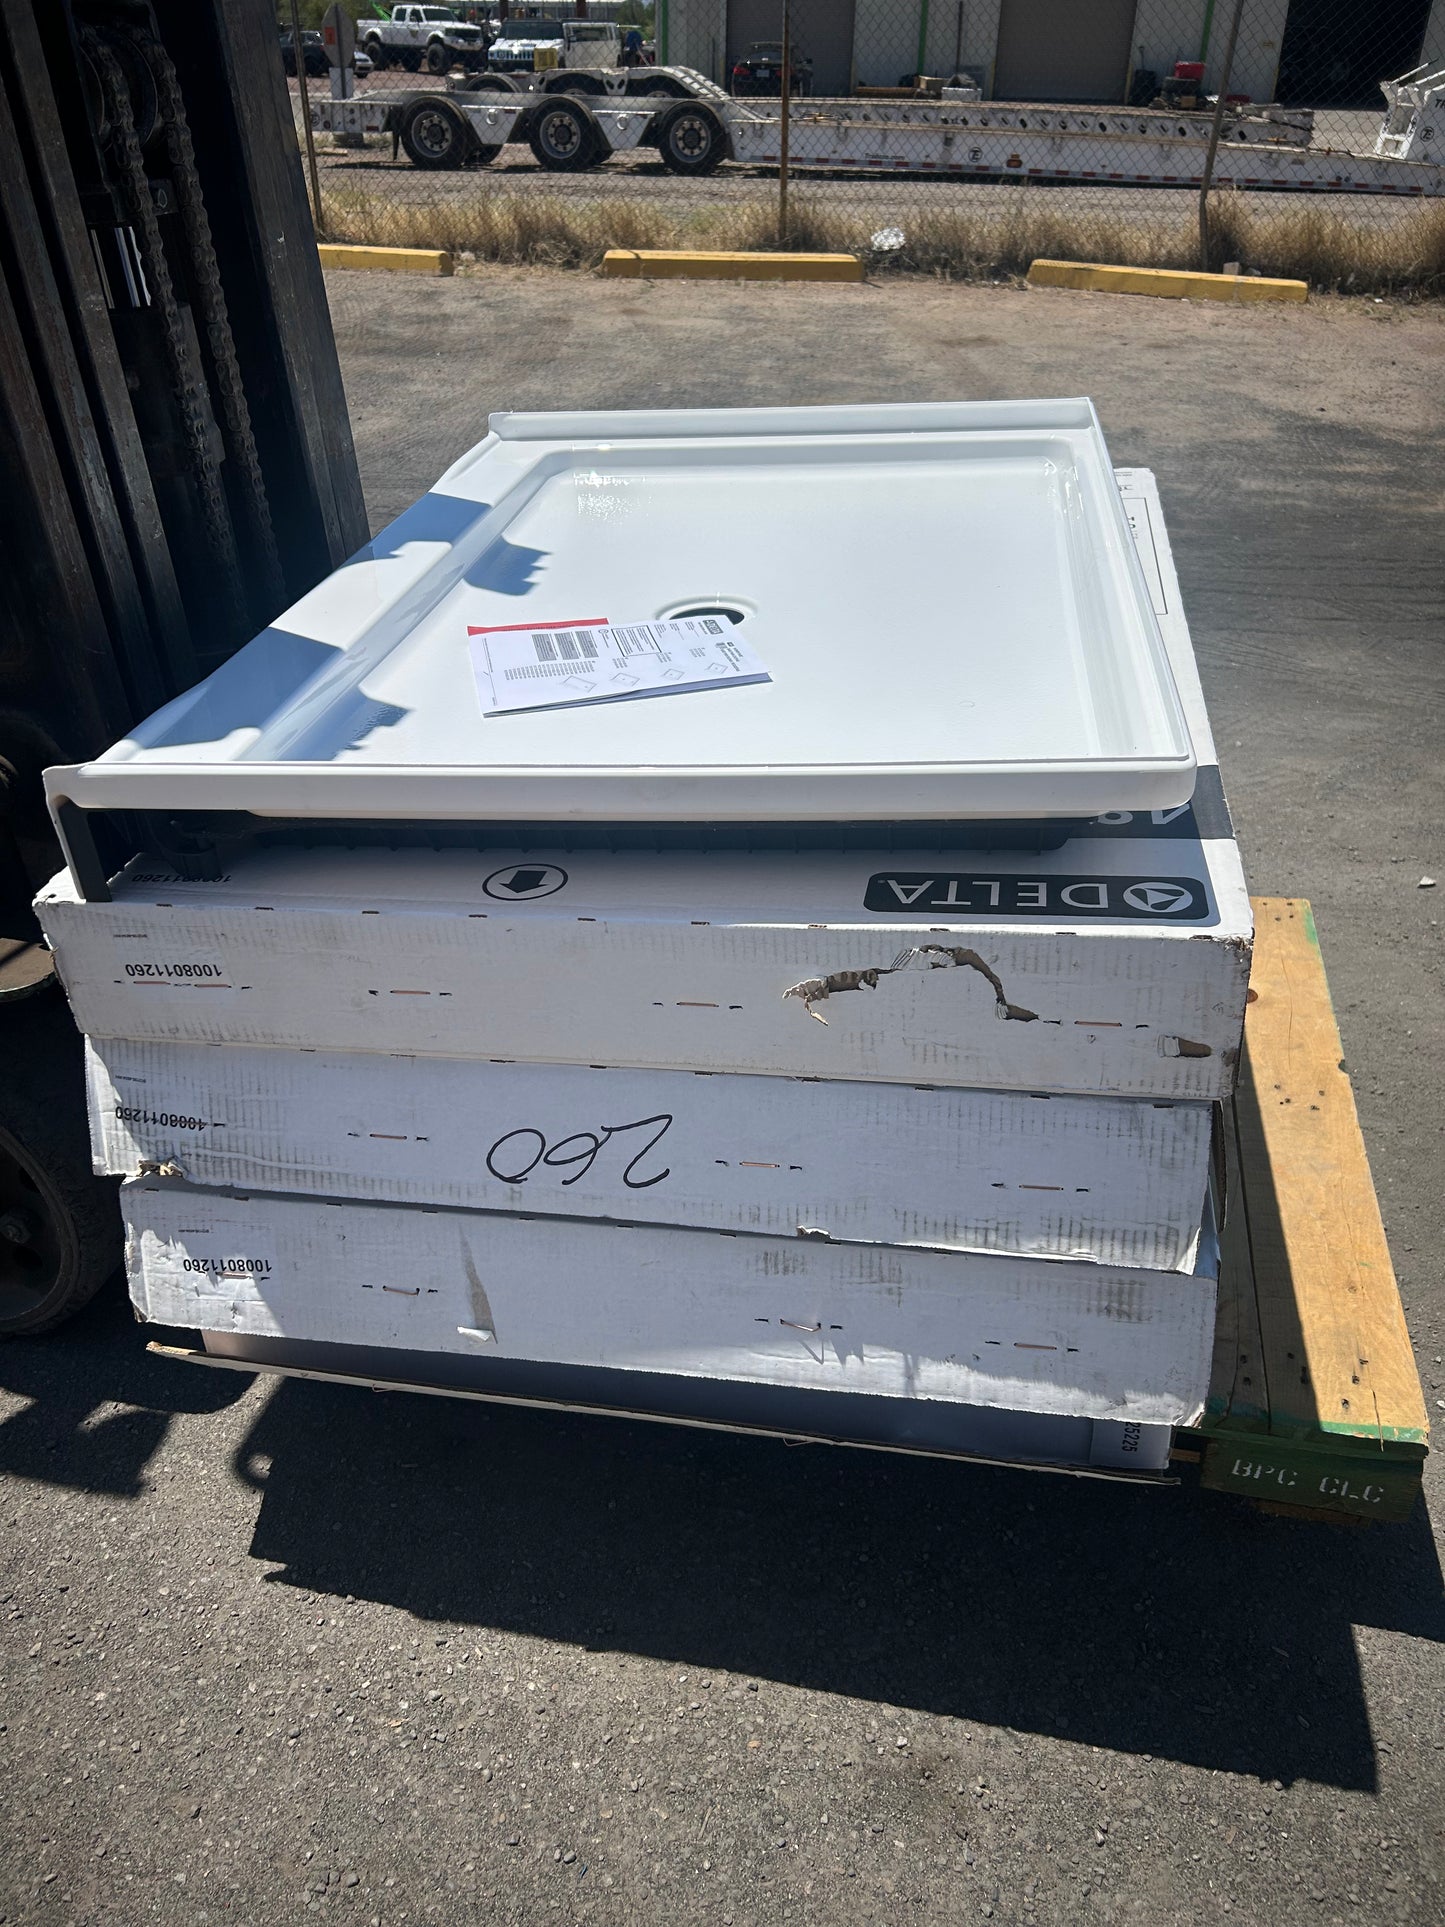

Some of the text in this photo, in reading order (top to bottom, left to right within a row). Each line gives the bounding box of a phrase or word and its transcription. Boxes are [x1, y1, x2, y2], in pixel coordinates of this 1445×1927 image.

[886, 879, 1110, 908] DELTA
[125, 964, 222, 977] 1008011260
[115, 1106, 206, 1131] 1008011260
[486, 1114, 673, 1189] 260
[183, 1259, 272, 1273] 1008011260
